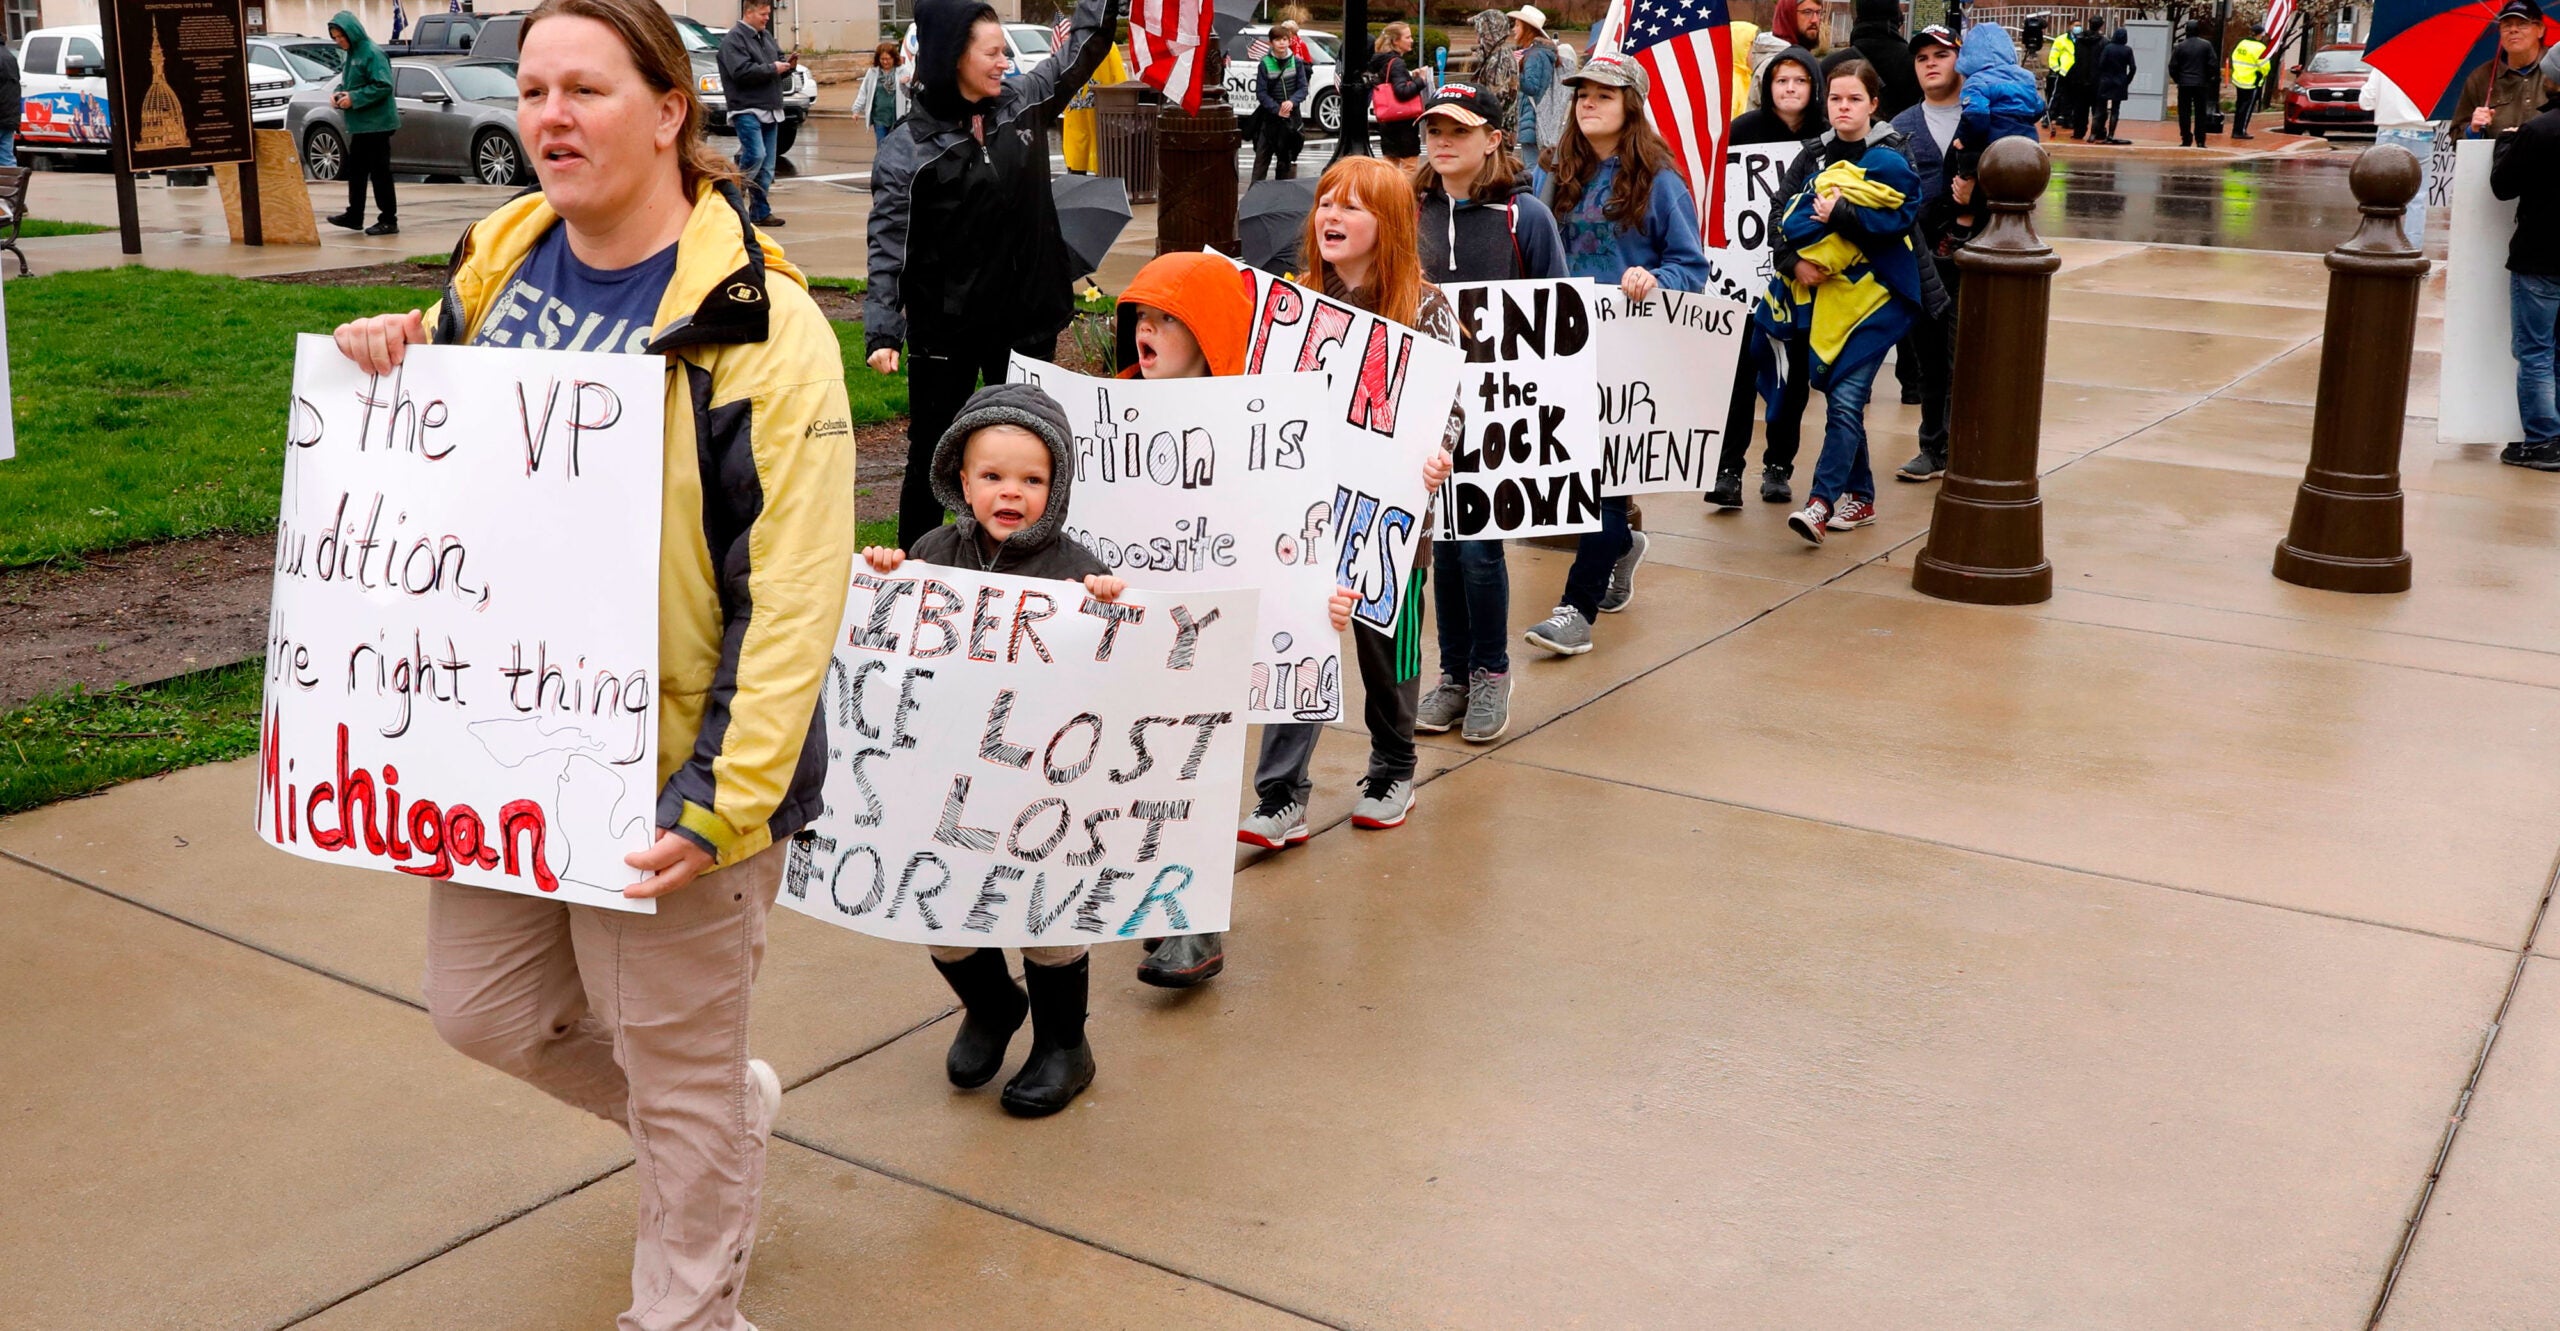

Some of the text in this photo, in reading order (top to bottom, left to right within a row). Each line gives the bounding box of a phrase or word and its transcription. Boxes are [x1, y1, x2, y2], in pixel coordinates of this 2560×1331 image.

[1459, 282, 1589, 364] END
[1661, 291, 1735, 336] VIRUS
[355, 361, 457, 462] the
[517, 374, 623, 481] VP
[1246, 398, 1309, 472] is
[1479, 371, 1538, 412] the
[1452, 405, 1571, 474] LOCK
[1275, 500, 1332, 566] of
[1456, 468, 1601, 536] DOWN
[848, 572, 1222, 671] IBERTY
[347, 627, 468, 738] right
[500, 640, 650, 765] thing
[821, 655, 1233, 787] NCE LOST
[257, 687, 560, 893] Michigan
[932, 773, 1196, 867] LOST
[786, 829, 1196, 938] FOREVER
